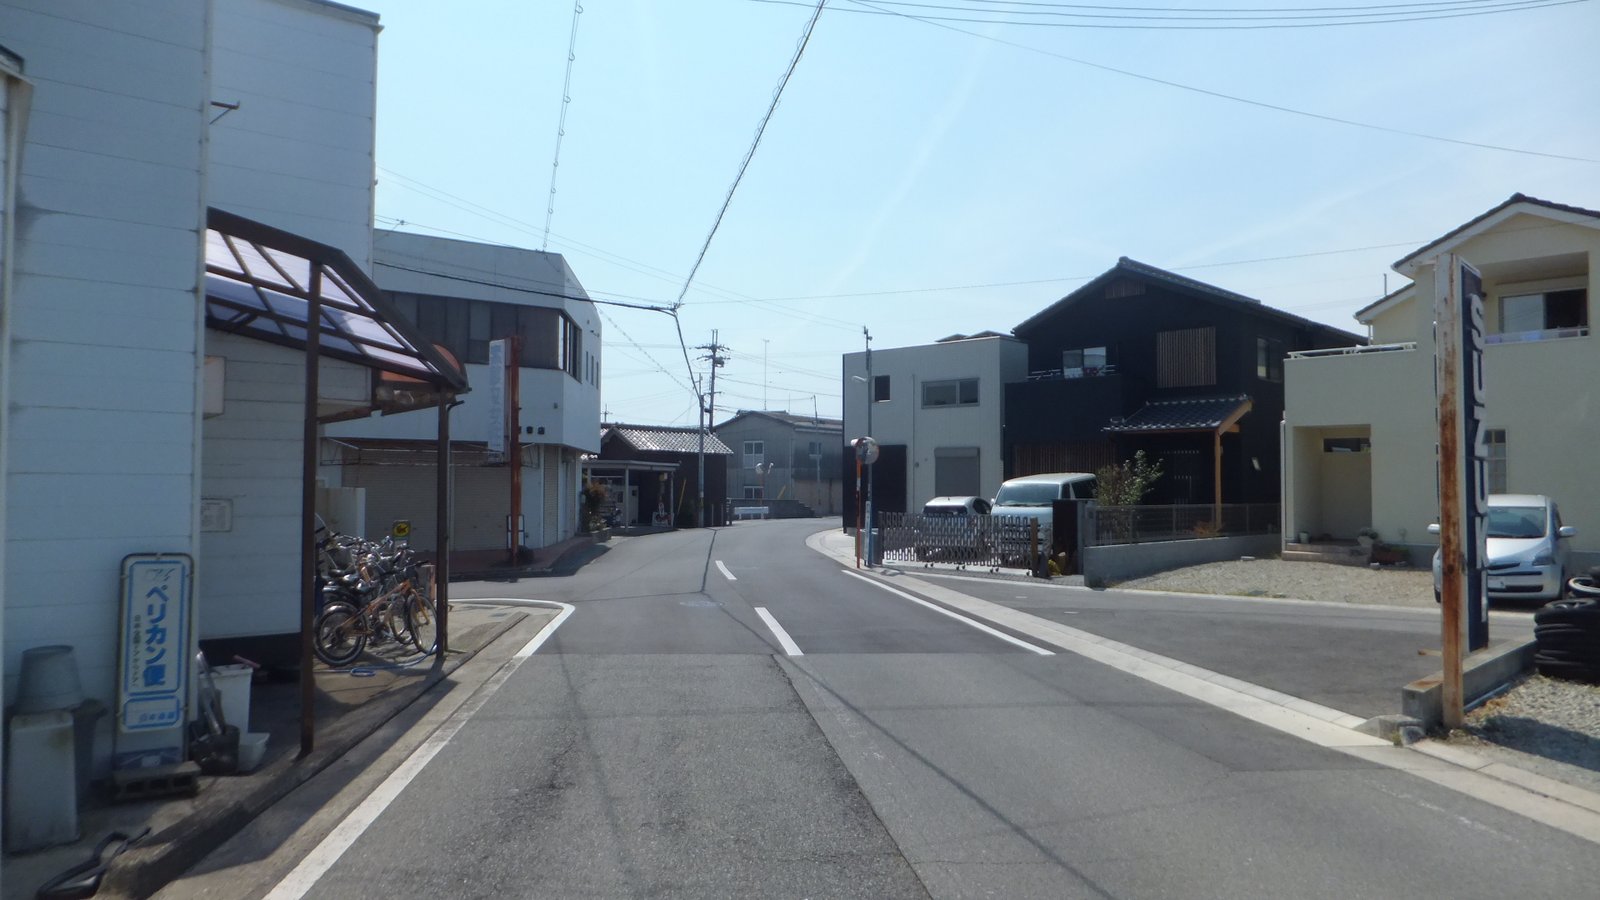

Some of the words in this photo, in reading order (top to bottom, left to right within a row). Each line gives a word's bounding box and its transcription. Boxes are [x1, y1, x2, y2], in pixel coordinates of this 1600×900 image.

[1470, 293, 1488, 622] SUZUKI
[144, 585, 169, 686] ペリカン便
